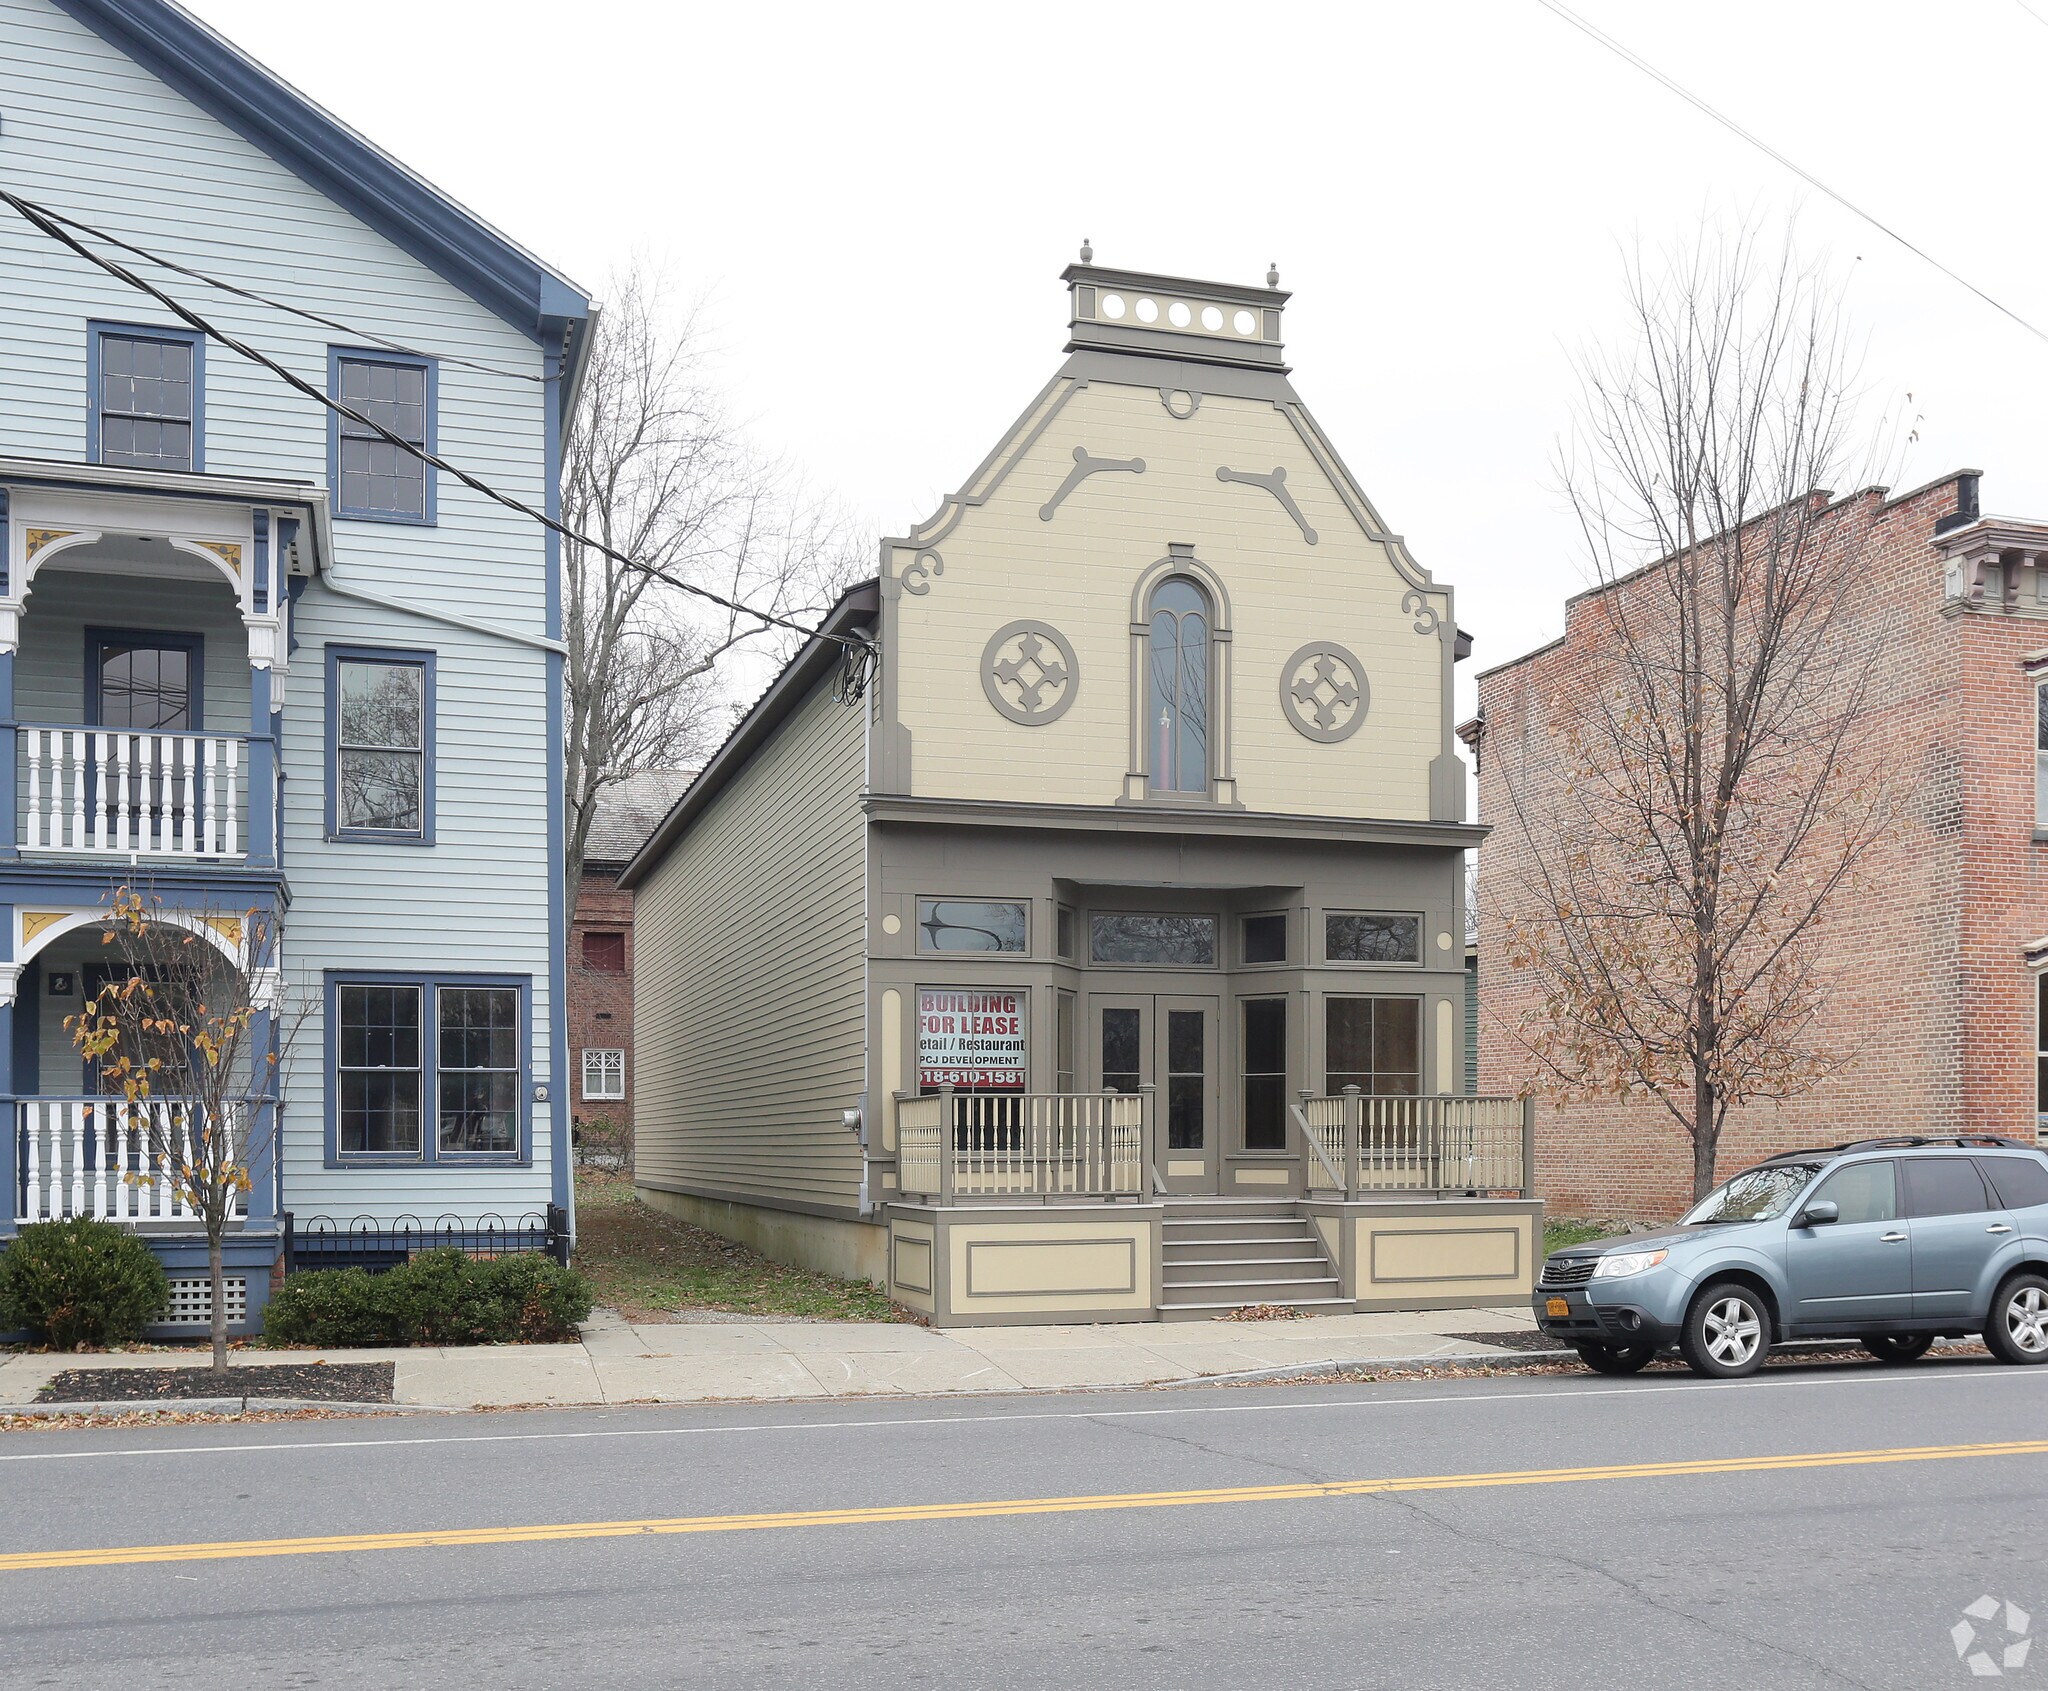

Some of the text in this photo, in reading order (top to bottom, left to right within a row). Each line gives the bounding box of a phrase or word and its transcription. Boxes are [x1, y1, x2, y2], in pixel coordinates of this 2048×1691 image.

[921, 994, 1016, 1013] BUILDING
[920, 1015, 1019, 1035] FOR LEASE
[949, 1037, 956, 1050] /
[959, 1037, 1025, 1051] Restaurant
[920, 1055, 1019, 1065] PCJ DEVELOPMENT
